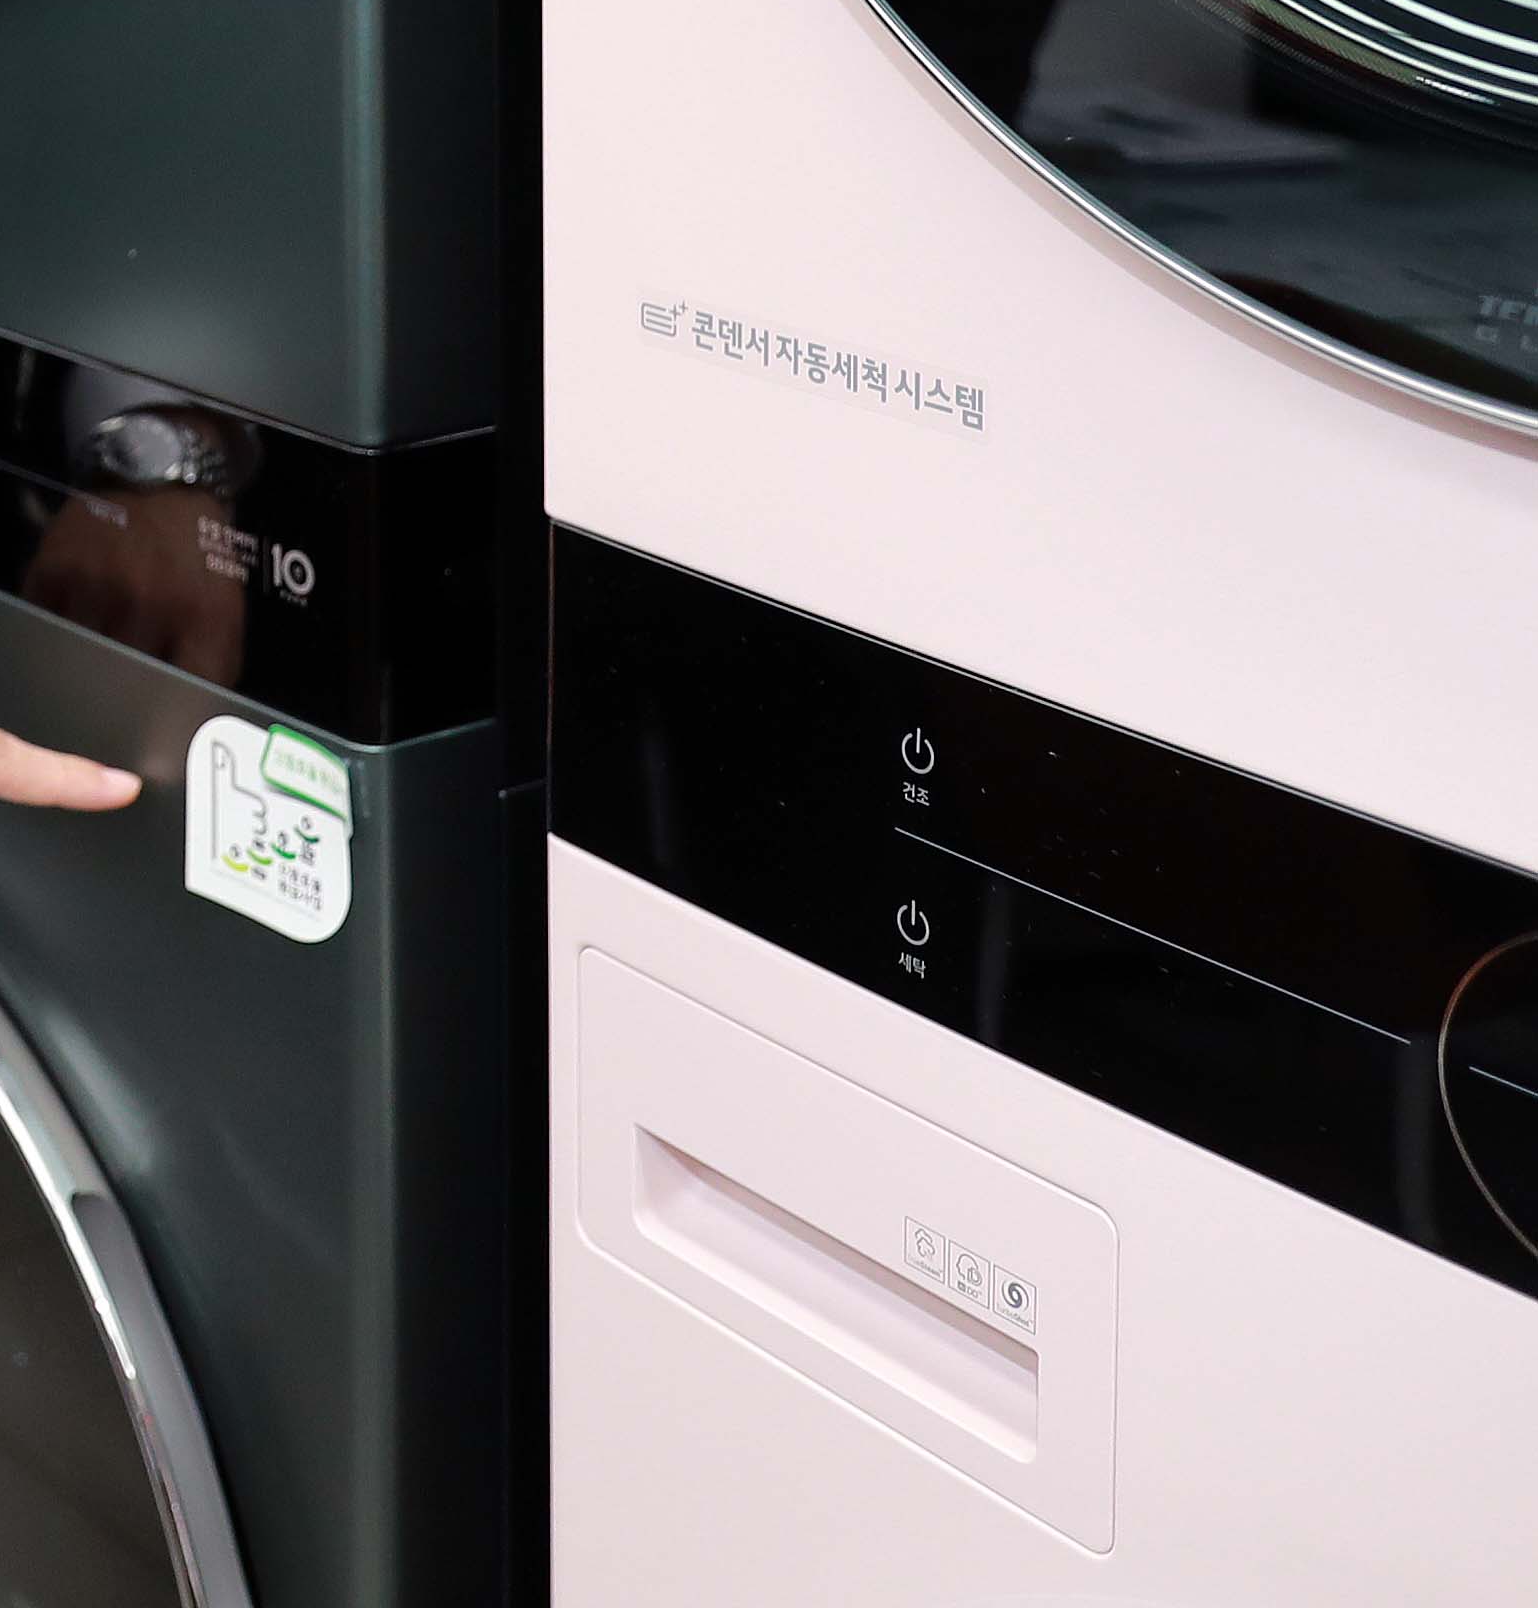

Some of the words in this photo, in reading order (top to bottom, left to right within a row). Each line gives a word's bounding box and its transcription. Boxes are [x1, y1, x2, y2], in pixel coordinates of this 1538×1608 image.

[691, 310, 770, 367] 콘덴서
[776, 333, 889, 404] 자동세척
[894, 368, 985, 432] 시스템
[902, 781, 930, 807] 건조
[898, 951, 927, 980] 세탁
